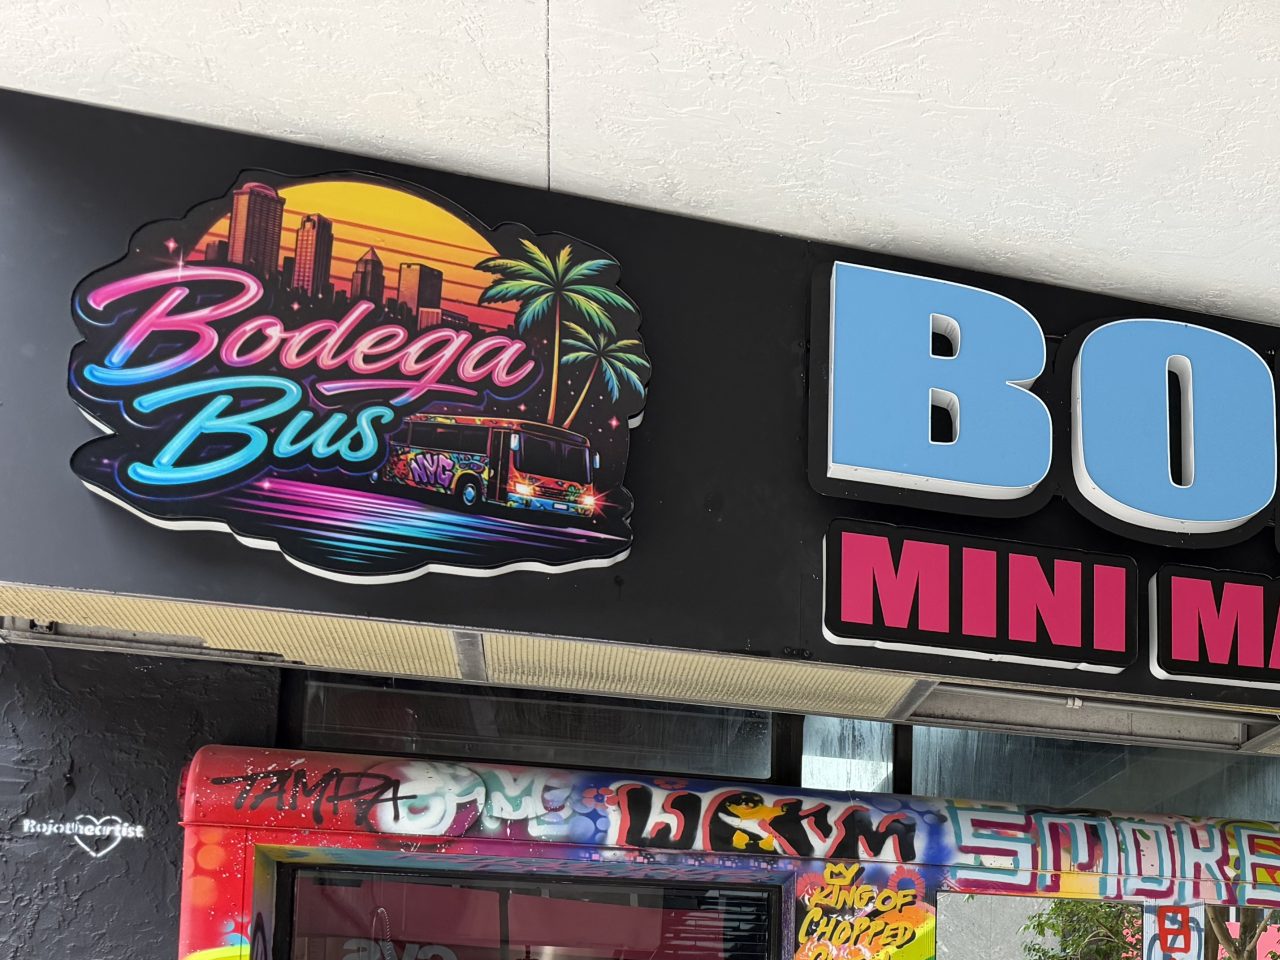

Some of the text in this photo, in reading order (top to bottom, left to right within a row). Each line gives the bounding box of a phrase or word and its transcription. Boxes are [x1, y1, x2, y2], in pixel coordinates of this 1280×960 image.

[84, 263, 536, 405] Bodega
[128, 376, 395, 485] Bus
[840, 530, 1127, 653] MINI
[211, 767, 418, 826] TAMPA
[798, 907, 916, 949] CHOPPED
[809, 883, 916, 913] KING OF
